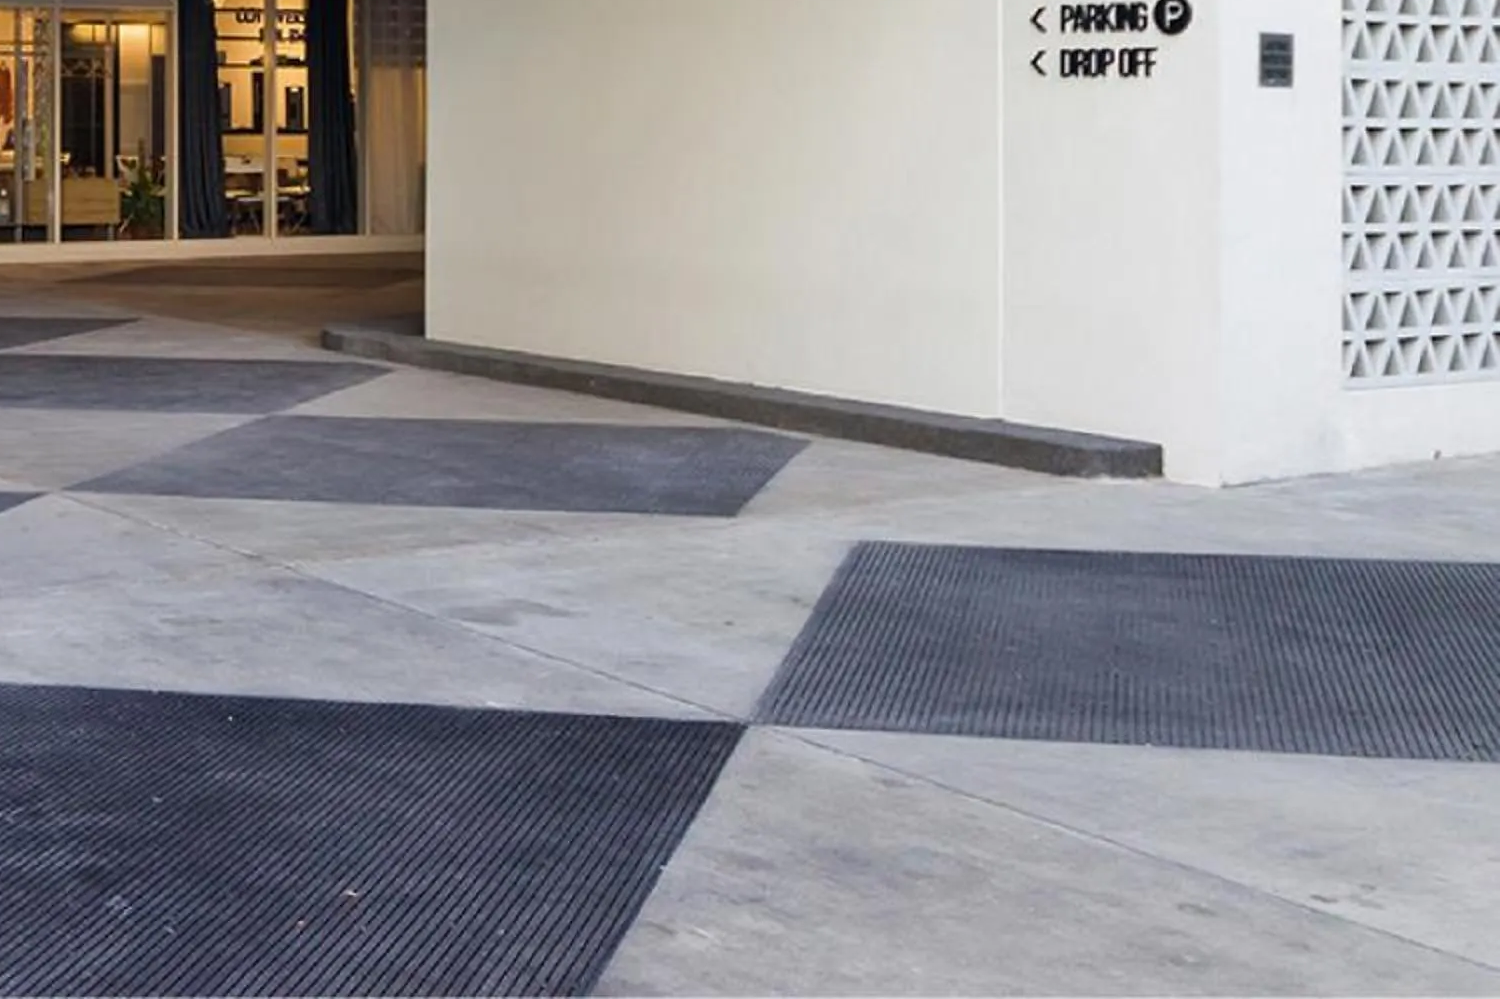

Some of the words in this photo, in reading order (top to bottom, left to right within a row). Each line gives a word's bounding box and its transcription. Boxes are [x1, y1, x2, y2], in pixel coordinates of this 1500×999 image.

[1060, 2, 1148, 33] PARKING
[1060, 48, 1115, 78] DROP
[1118, 47, 1158, 78] OFF
